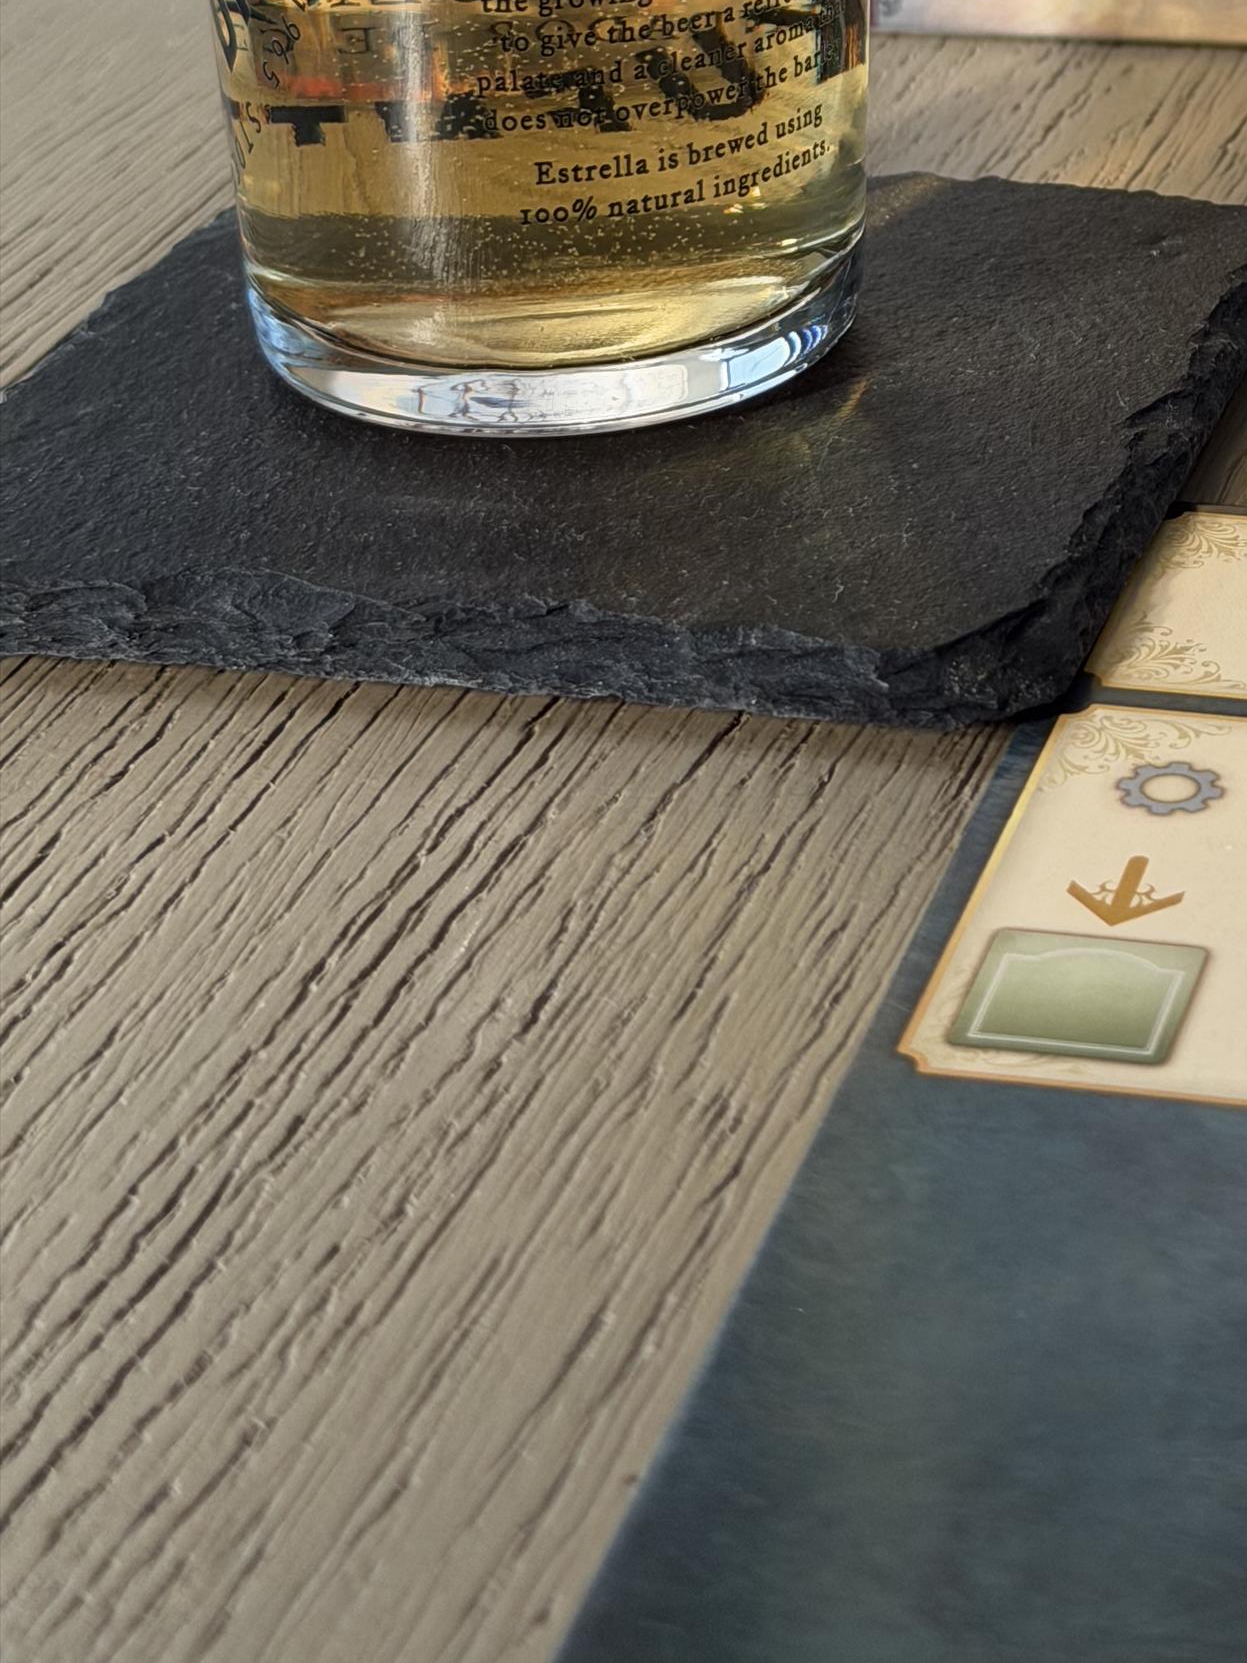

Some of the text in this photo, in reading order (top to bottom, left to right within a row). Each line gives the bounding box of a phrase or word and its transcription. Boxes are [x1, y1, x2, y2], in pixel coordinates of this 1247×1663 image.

[475, 68, 568, 99] palate
[576, 59, 624, 86] and
[633, 61, 649, 80] a
[656, 41, 747, 78] cleaner
[754, 17, 815, 53] aroma
[500, 30, 530, 53] to
[540, 25, 597, 57] give
[607, 18, 651, 44] the
[660, 10, 716, 38] beer
[722, 6, 736, 23] a
[485, 104, 546, 131] does
[616, 80, 755, 123] overpower
[756, 65, 789, 92] the
[520, 140, 832, 226] 100% natural ingredients.
[534, 102, 824, 186] Estrella is brewed using
